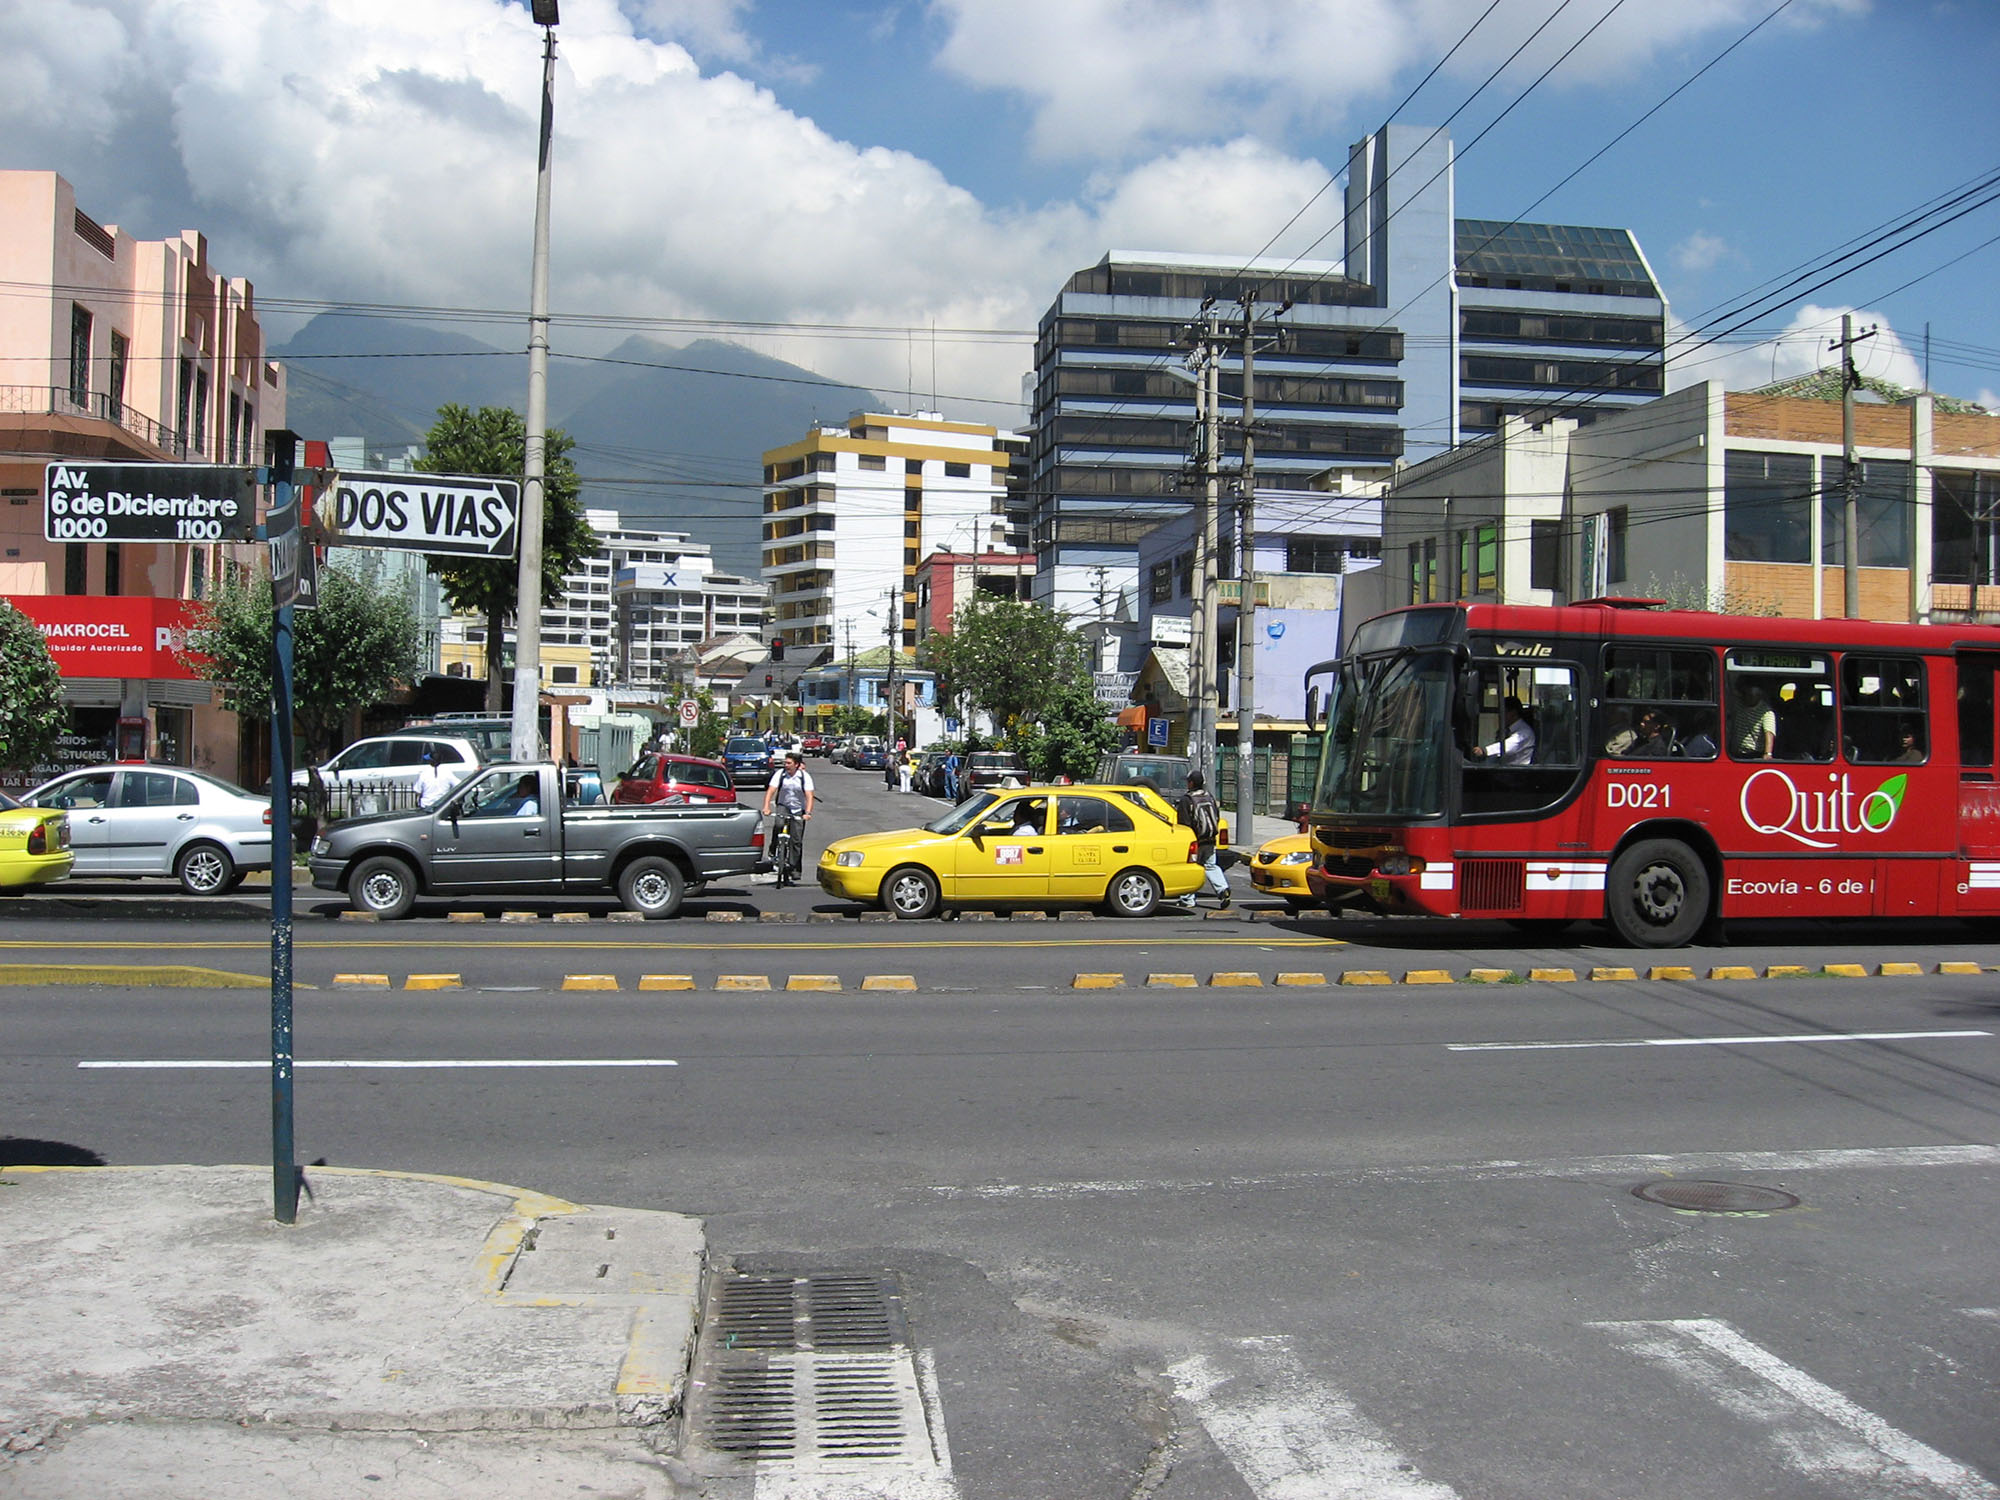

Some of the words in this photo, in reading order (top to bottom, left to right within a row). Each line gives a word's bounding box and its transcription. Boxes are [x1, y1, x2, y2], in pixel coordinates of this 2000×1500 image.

[52, 466, 89, 489] Av.
[51, 491, 68, 515] 6
[70, 492, 105, 515] de
[107, 492, 238, 517] Diciembre
[336, 487, 408, 532] DOS
[420, 492, 503, 538] VIAS
[53, 518, 108, 538] 1000
[177, 519, 222, 539] 1100
[39, 624, 130, 637] MAKROCEL
[1607, 783, 1671, 808] D021
[1740, 768, 1895, 848] Quito
[1727, 878, 1798, 894] Ecovía
[1819, 879, 1832, 894] 6
[1838, 879, 1863, 894] de
[1957, 883, 1969, 895] e
